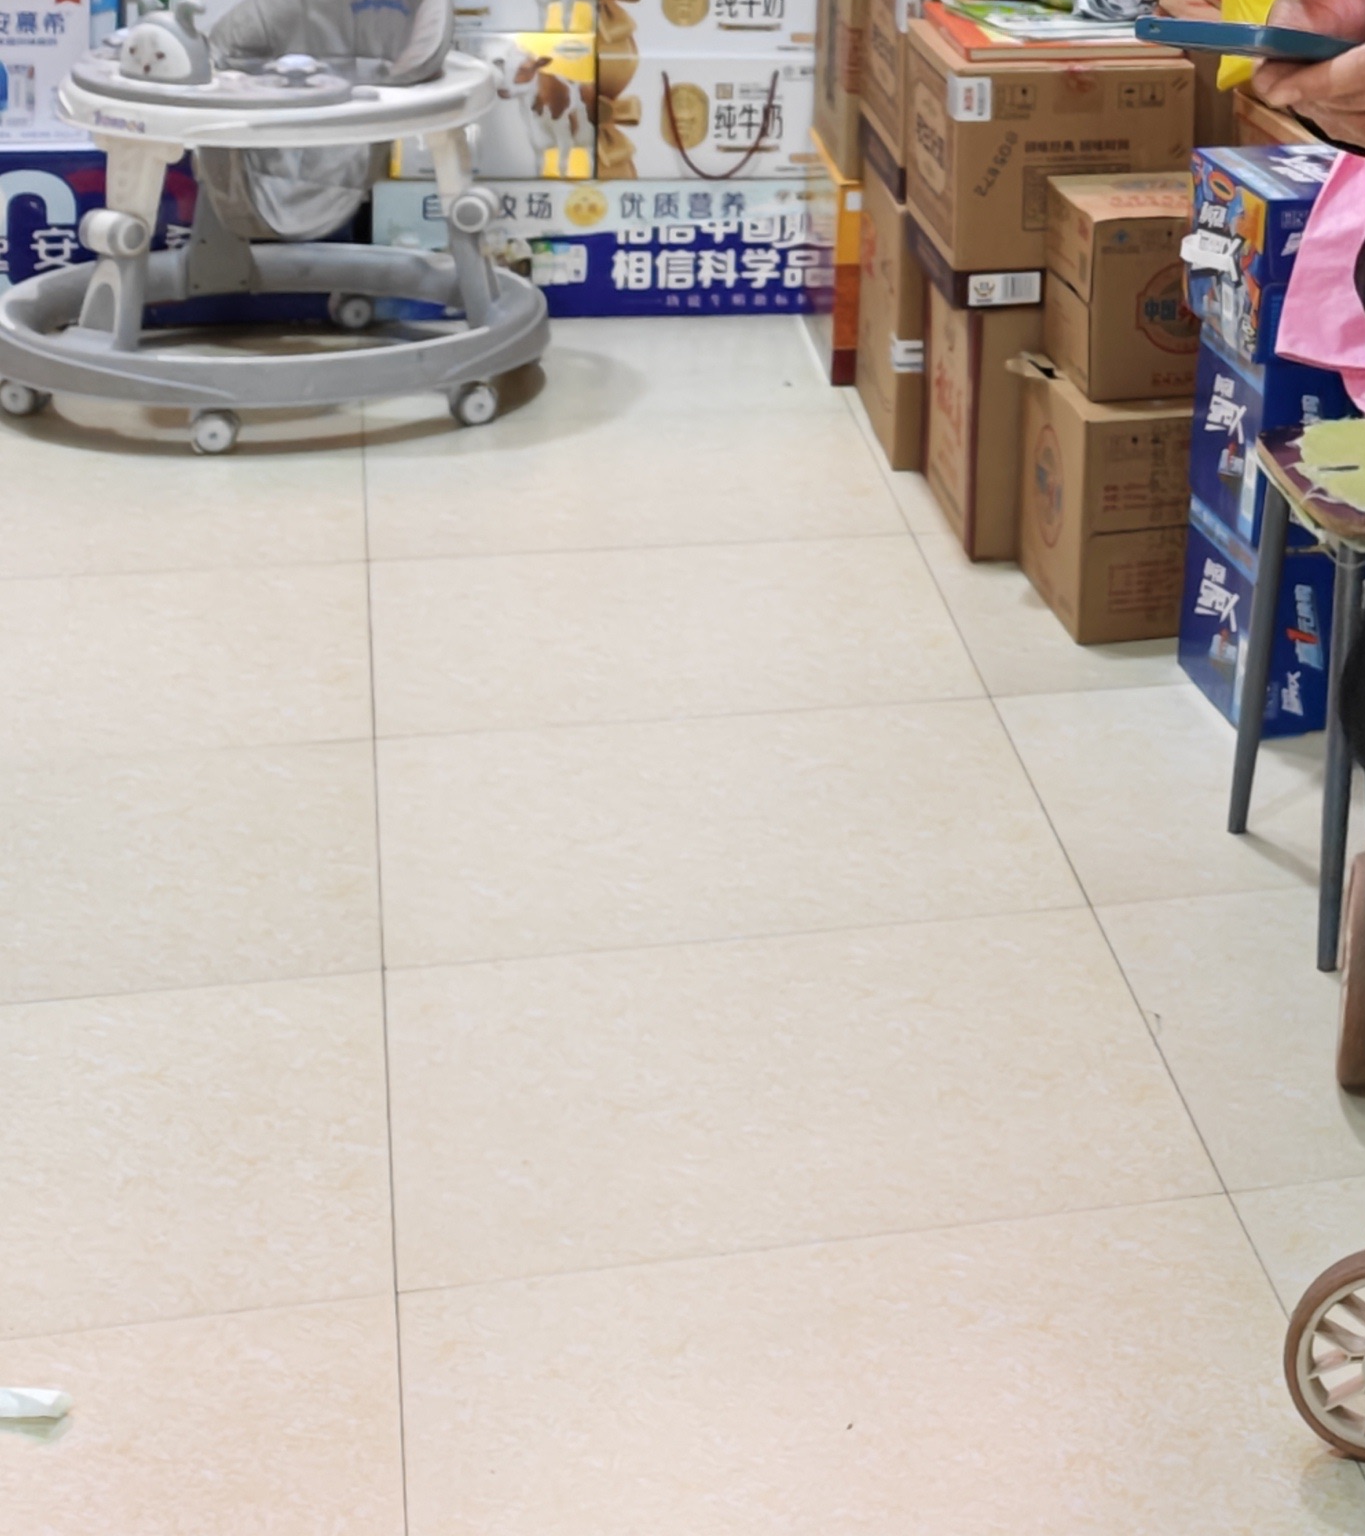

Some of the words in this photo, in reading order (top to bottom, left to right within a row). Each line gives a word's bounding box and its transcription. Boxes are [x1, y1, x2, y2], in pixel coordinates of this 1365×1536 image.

[714, 103, 784, 140] 纯牛奶
[619, 191, 746, 220] 优质营养
